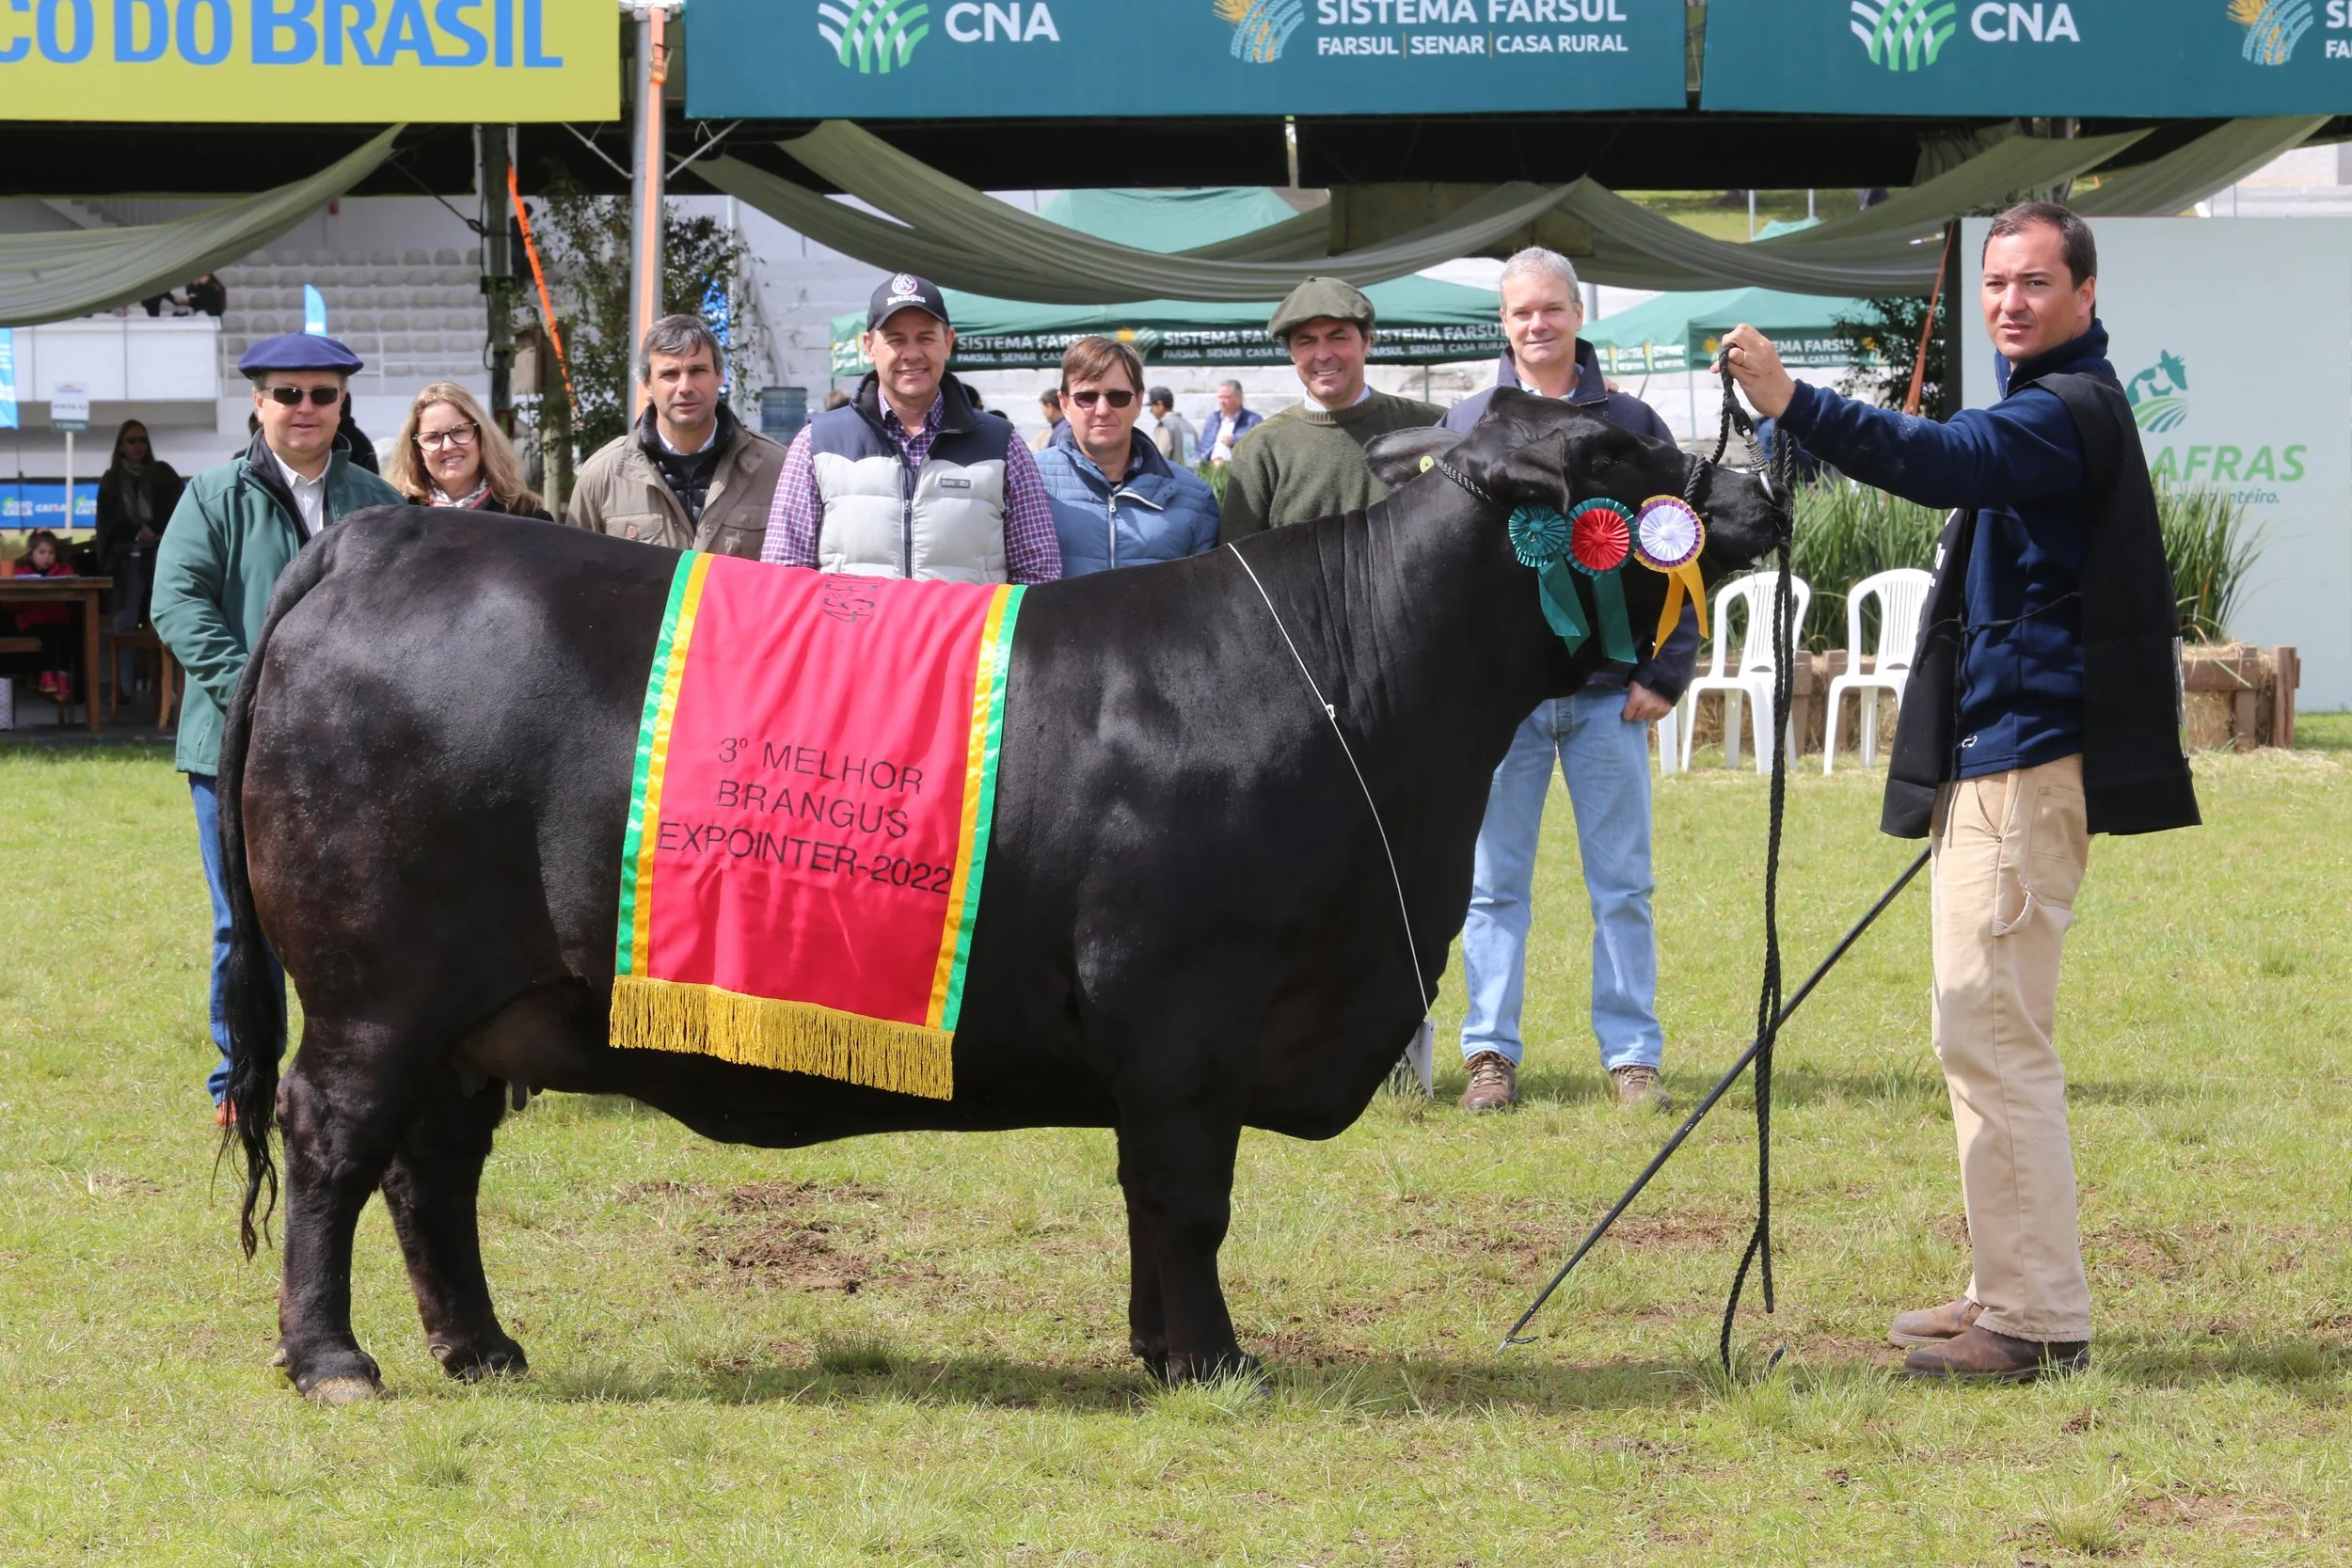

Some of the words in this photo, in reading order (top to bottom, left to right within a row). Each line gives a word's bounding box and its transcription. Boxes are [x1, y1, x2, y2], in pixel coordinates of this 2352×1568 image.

[945, 2, 1060, 42] CNA
[1317, 0, 1479, 25] SISTEMA
[1487, 0, 1628, 24] FARSUL
[1971, 2, 2081, 42] CNA
[114, 0, 232, 65] DO
[251, 0, 564, 68] BRASIL
[1317, 36, 1400, 55] FARSUL
[1410, 35, 1486, 55] SENAR
[1496, 35, 1554, 54] CASA
[1558, 34, 1629, 53] RURAL
[957, 335, 1034, 351] SISTEMA
[1163, 330, 1238, 346] SISTEMA
[1409, 344, 1445, 355] SENAR
[1448, 342, 1476, 353] CASA
[957, 353, 996, 363] FARSUL
[1000, 352, 1037, 362] SENAR
[1041, 352, 1063, 362] CAS
[1206, 348, 1243, 358] SENAR
[1246, 347, 1273, 357] CASA
[762, 741, 923, 796] MELHOR
[716, 779, 909, 840] BRANGUS
[658, 820, 952, 895] EXPOINTER-2022
